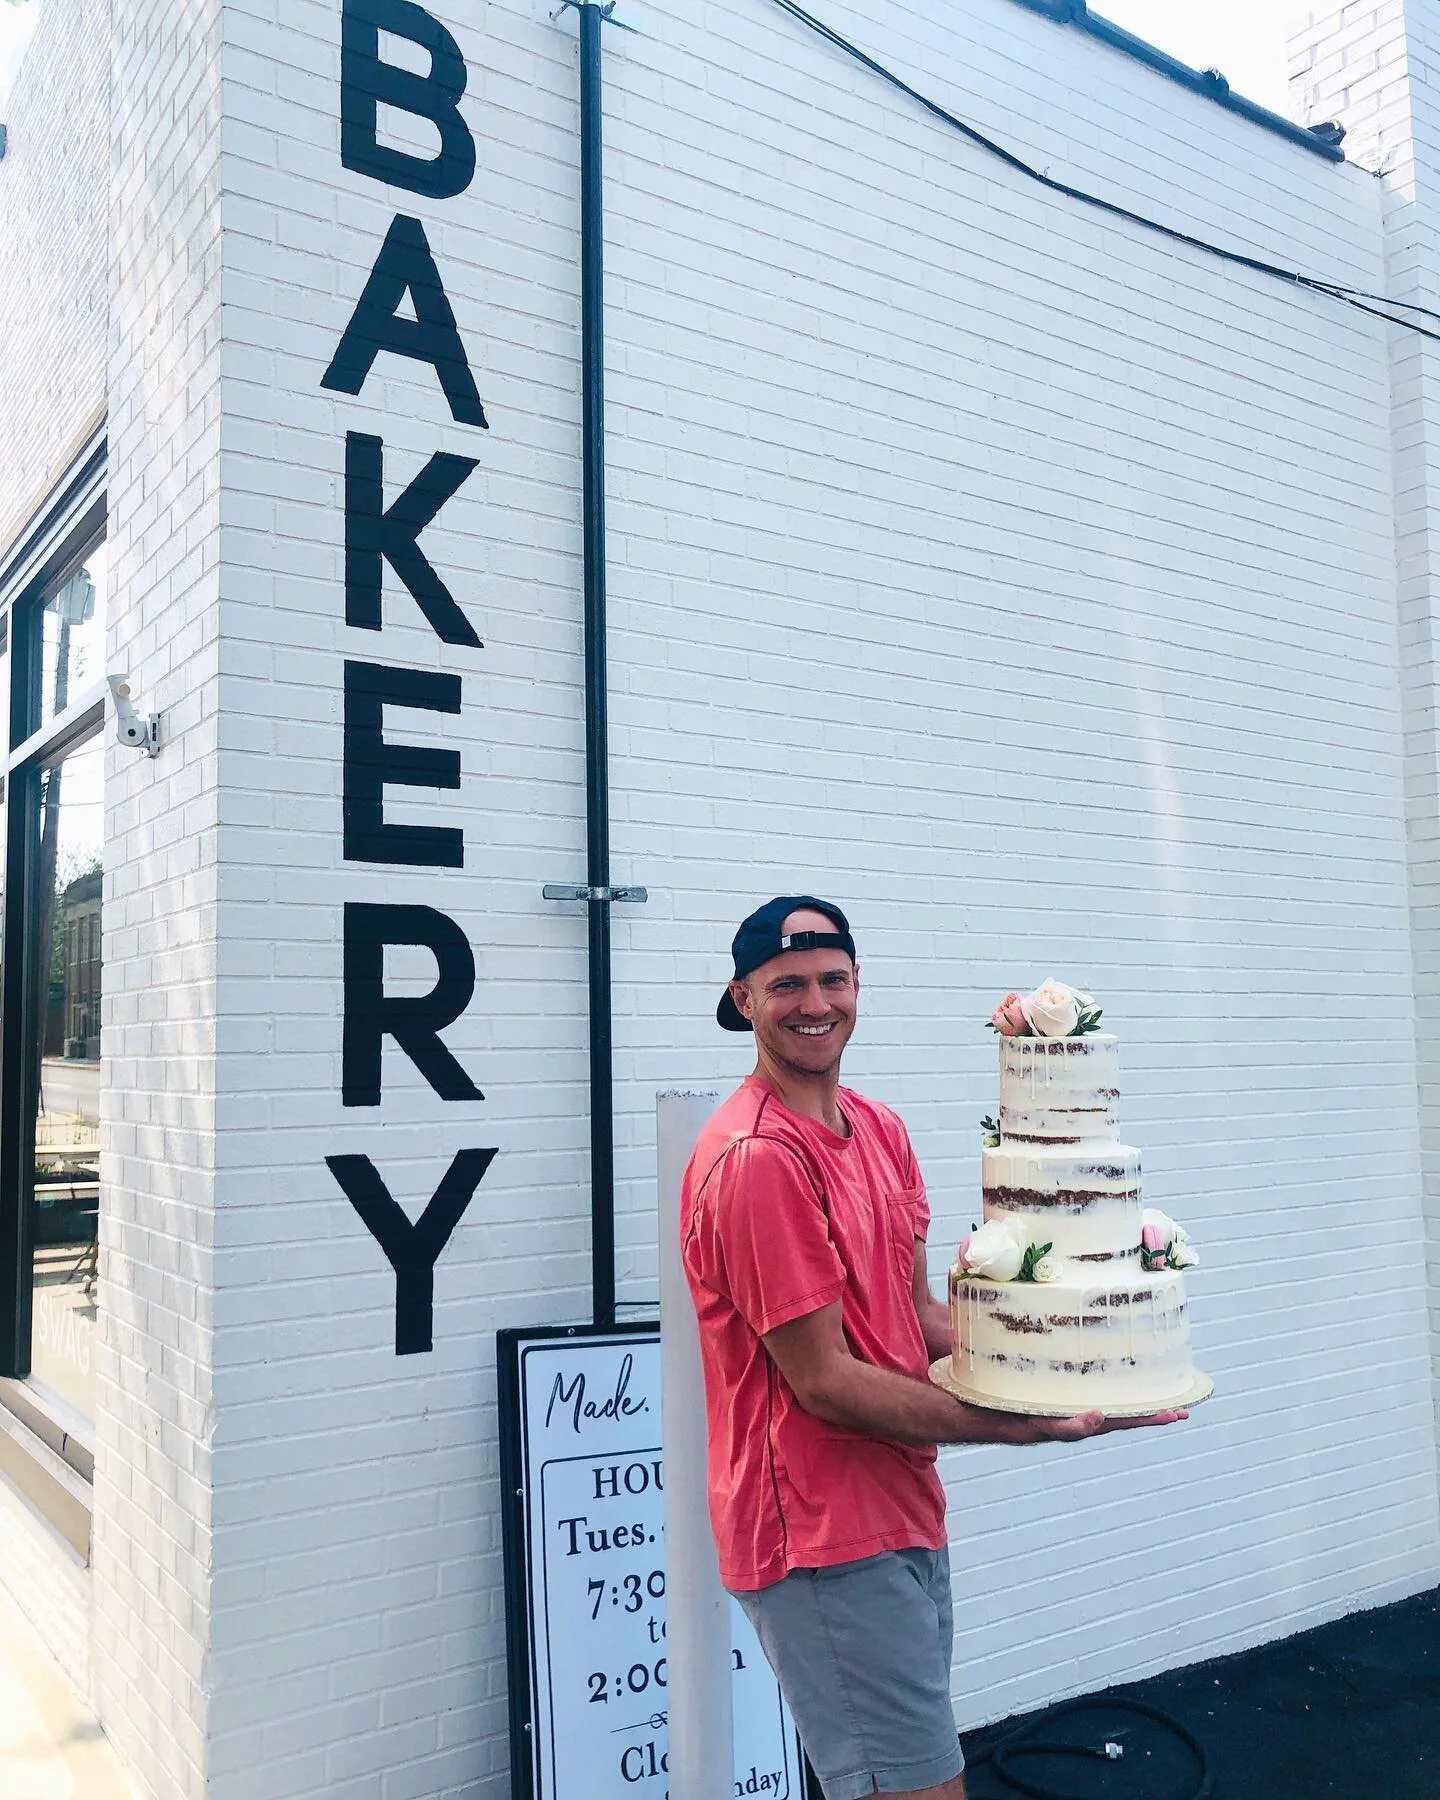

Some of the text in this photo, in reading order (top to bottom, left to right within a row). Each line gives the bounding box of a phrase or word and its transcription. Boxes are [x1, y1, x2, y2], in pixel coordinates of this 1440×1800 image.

[319, 0, 499, 1356] BAKERY
[545, 1353, 650, 1434] Made.
[591, 1461, 664, 1499] HOU
[557, 1516, 656, 1556] Tues.
[587, 1569, 666, 1621] 7:30
[587, 1657, 668, 1705] 2:00
[734, 1766, 783, 1798] nday
